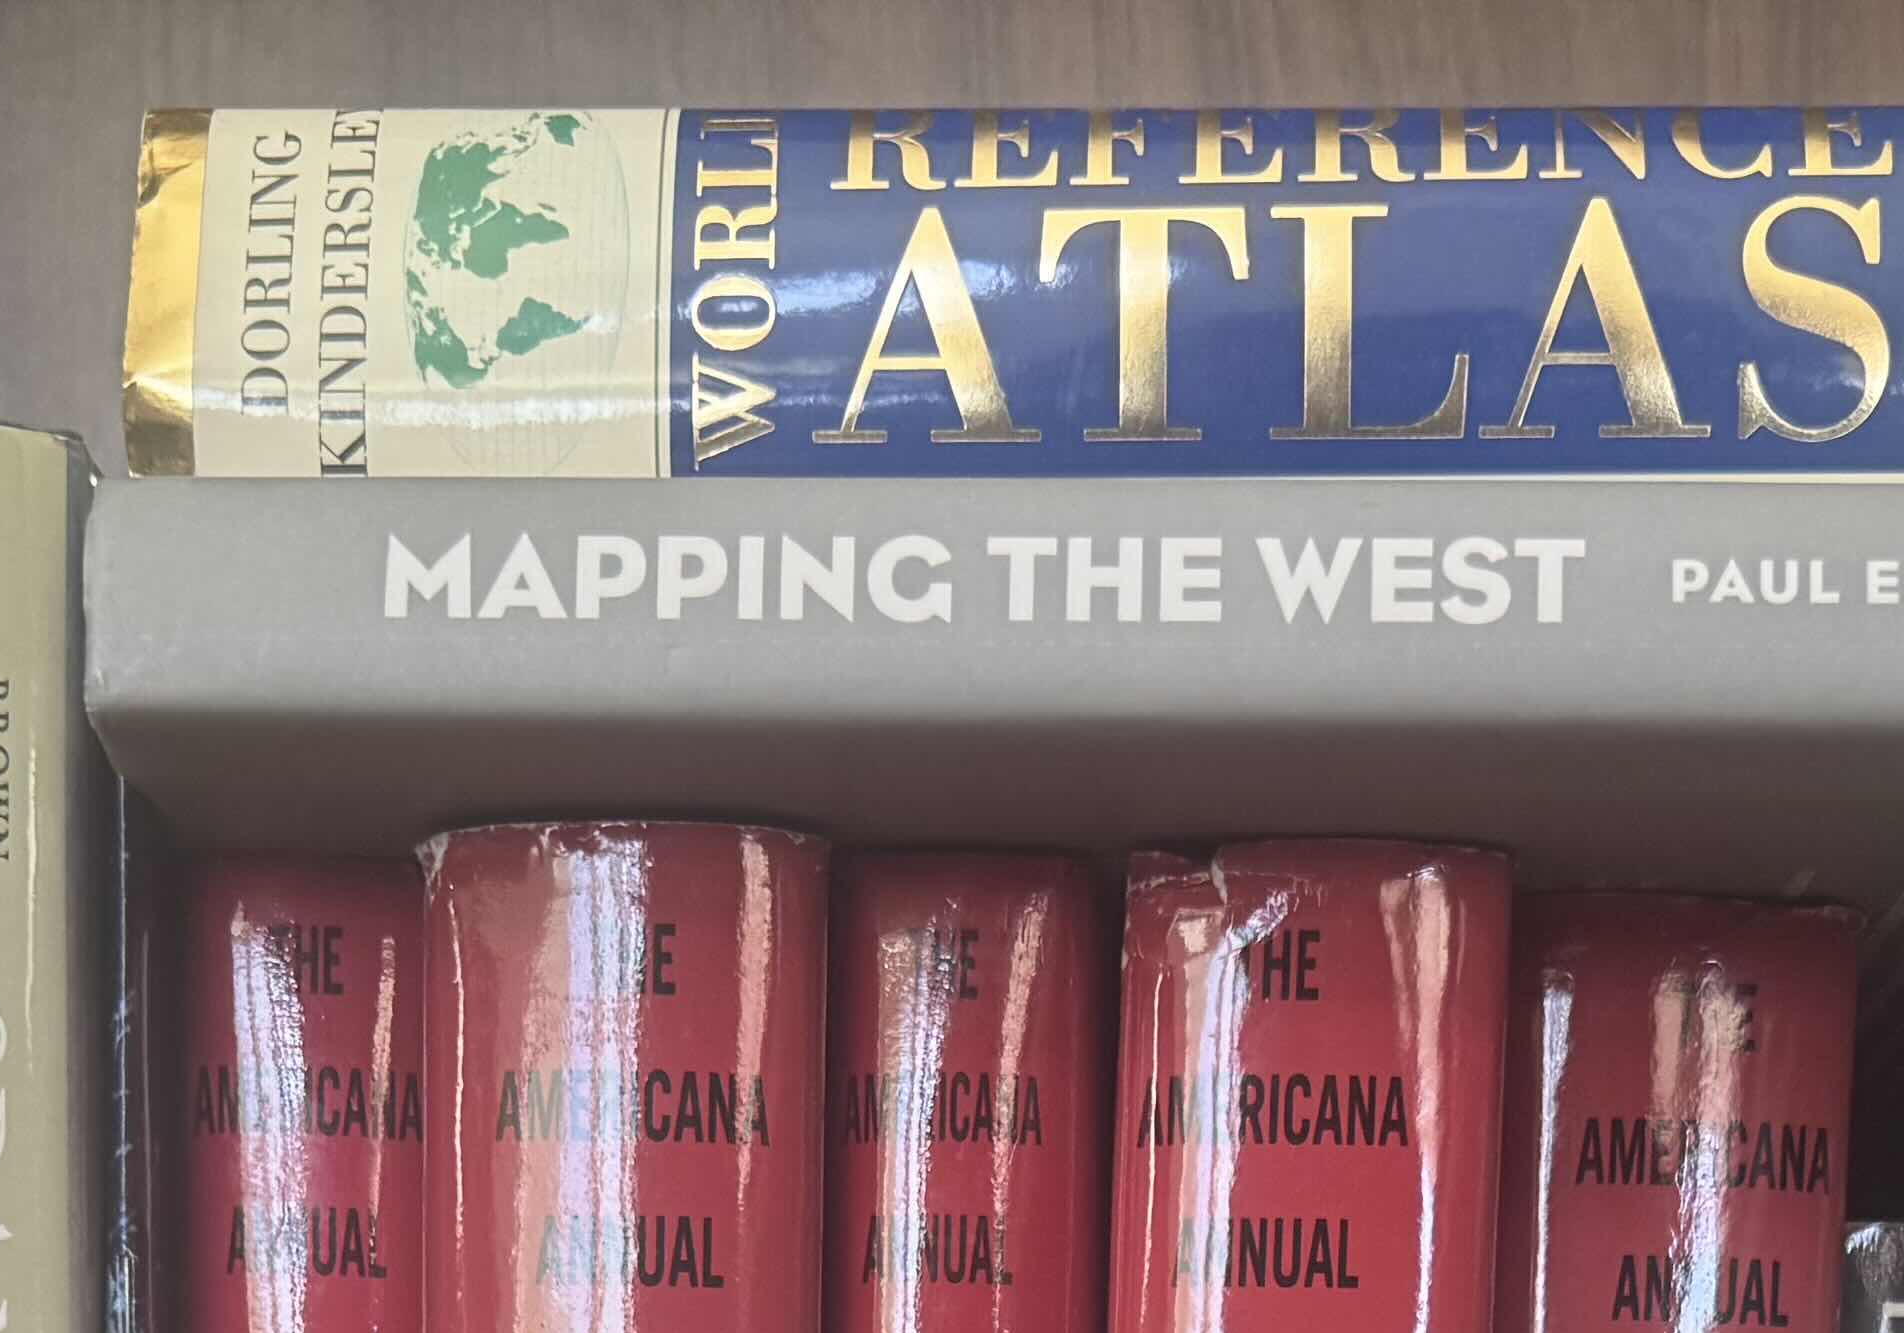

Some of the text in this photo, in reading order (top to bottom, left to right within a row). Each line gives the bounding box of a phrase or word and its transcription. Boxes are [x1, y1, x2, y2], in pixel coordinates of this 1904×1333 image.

[239, 129, 303, 416] DORLING
[811, 195, 1892, 444] ATLAS
[382, 530, 1587, 627] MAPPING THE WEST
[1671, 558, 1840, 605] PAUL
